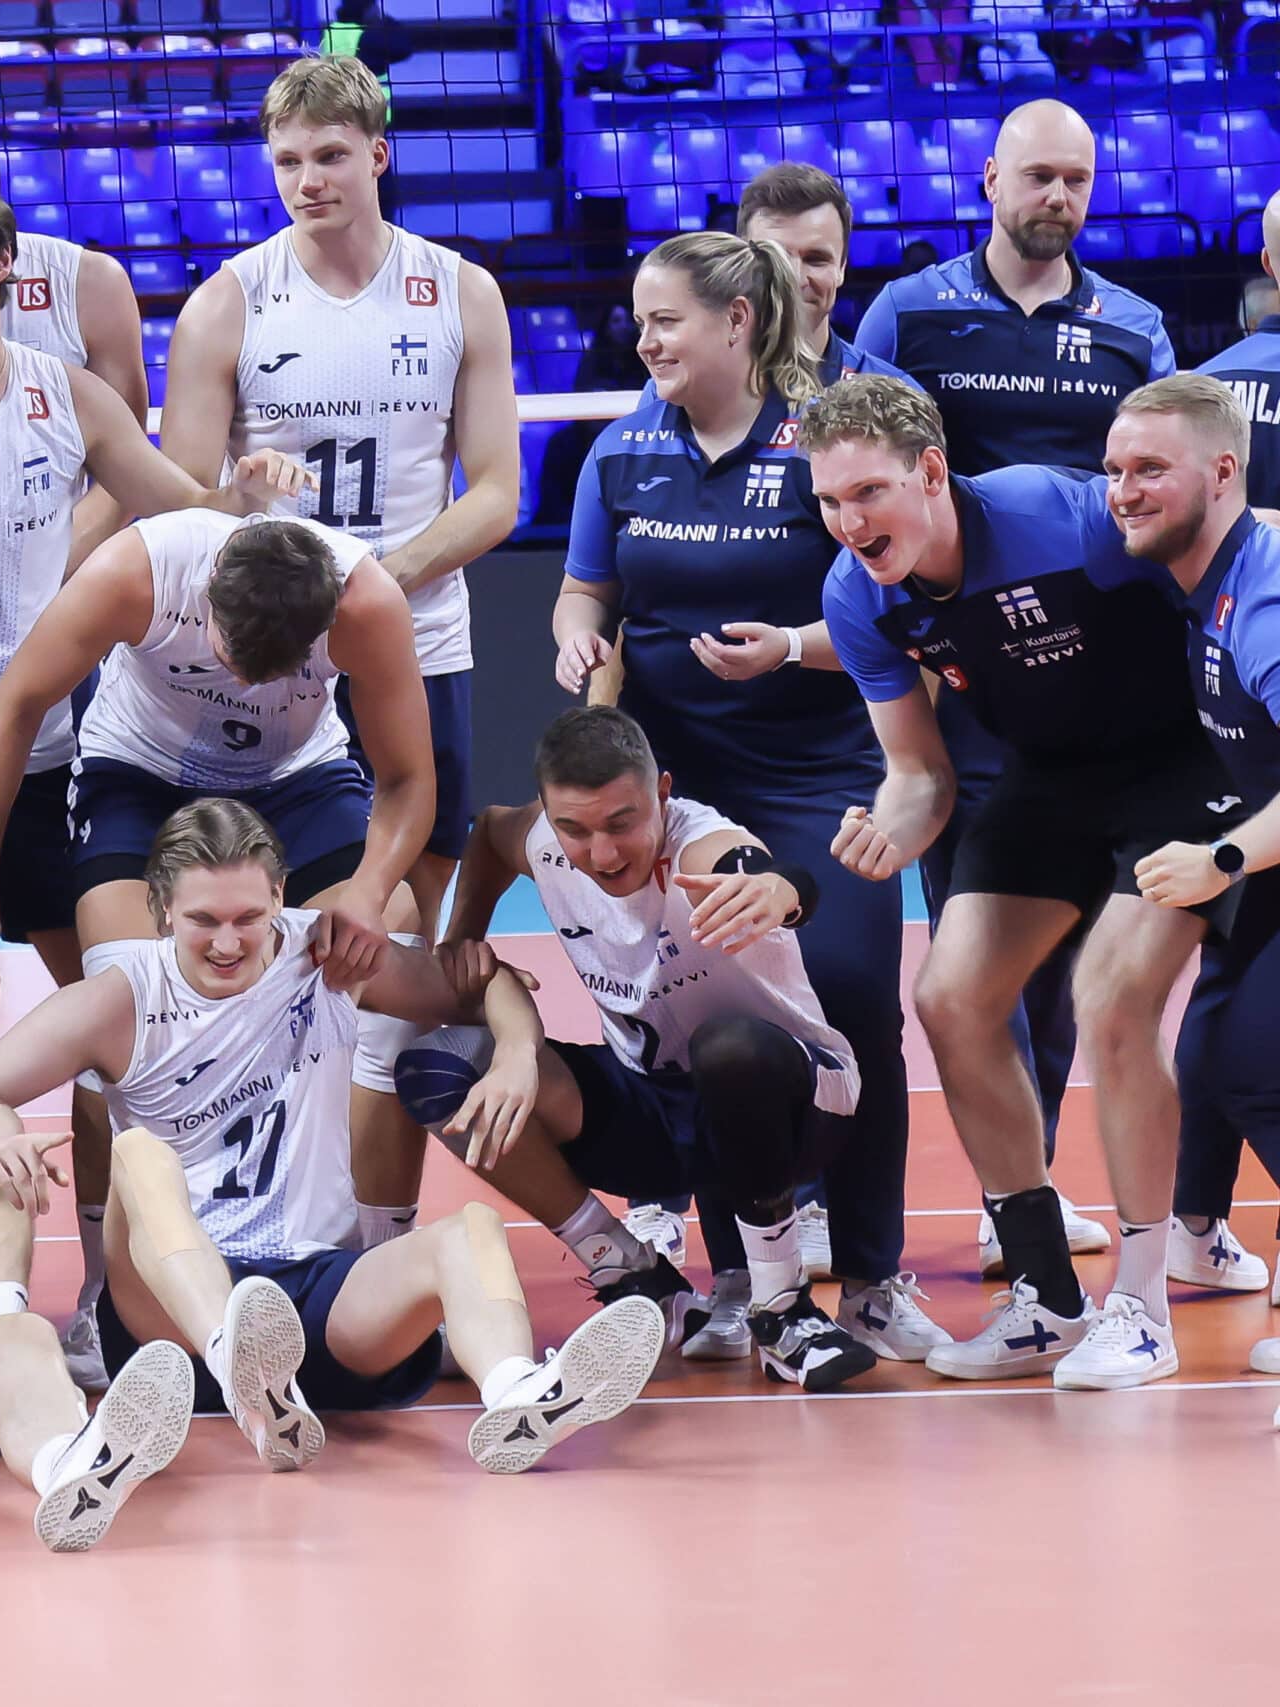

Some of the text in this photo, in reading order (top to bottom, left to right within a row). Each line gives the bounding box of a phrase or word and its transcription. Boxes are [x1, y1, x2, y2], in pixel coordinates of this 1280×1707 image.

[21, 280, 47, 306] IS
[408, 280, 434, 304] IS
[1056, 345, 1092, 364] FIN
[392, 358, 428, 376] FIN
[937, 372, 1117, 397] TOKMANNI RÉVVI
[256, 400, 438, 420] TOKMANNI RÉVVI
[622, 430, 675, 443] RÉVVI
[24, 472, 50, 496] FIN
[305, 437, 383, 528] 11
[744, 489, 781, 507] FIN
[627, 517, 789, 542] TOKMANNI RÉVVI
[1006, 607, 1049, 630] FIN
[1025, 626, 1082, 648] Kuortane
[1024, 643, 1085, 667] RÉVVI
[222, 719, 263, 752] 9
[656, 943, 680, 965] IN
[146, 1010, 200, 1025] RÉVVI
[171, 1075, 274, 1134] TOKMANNI
[213, 1099, 287, 1200] 17
